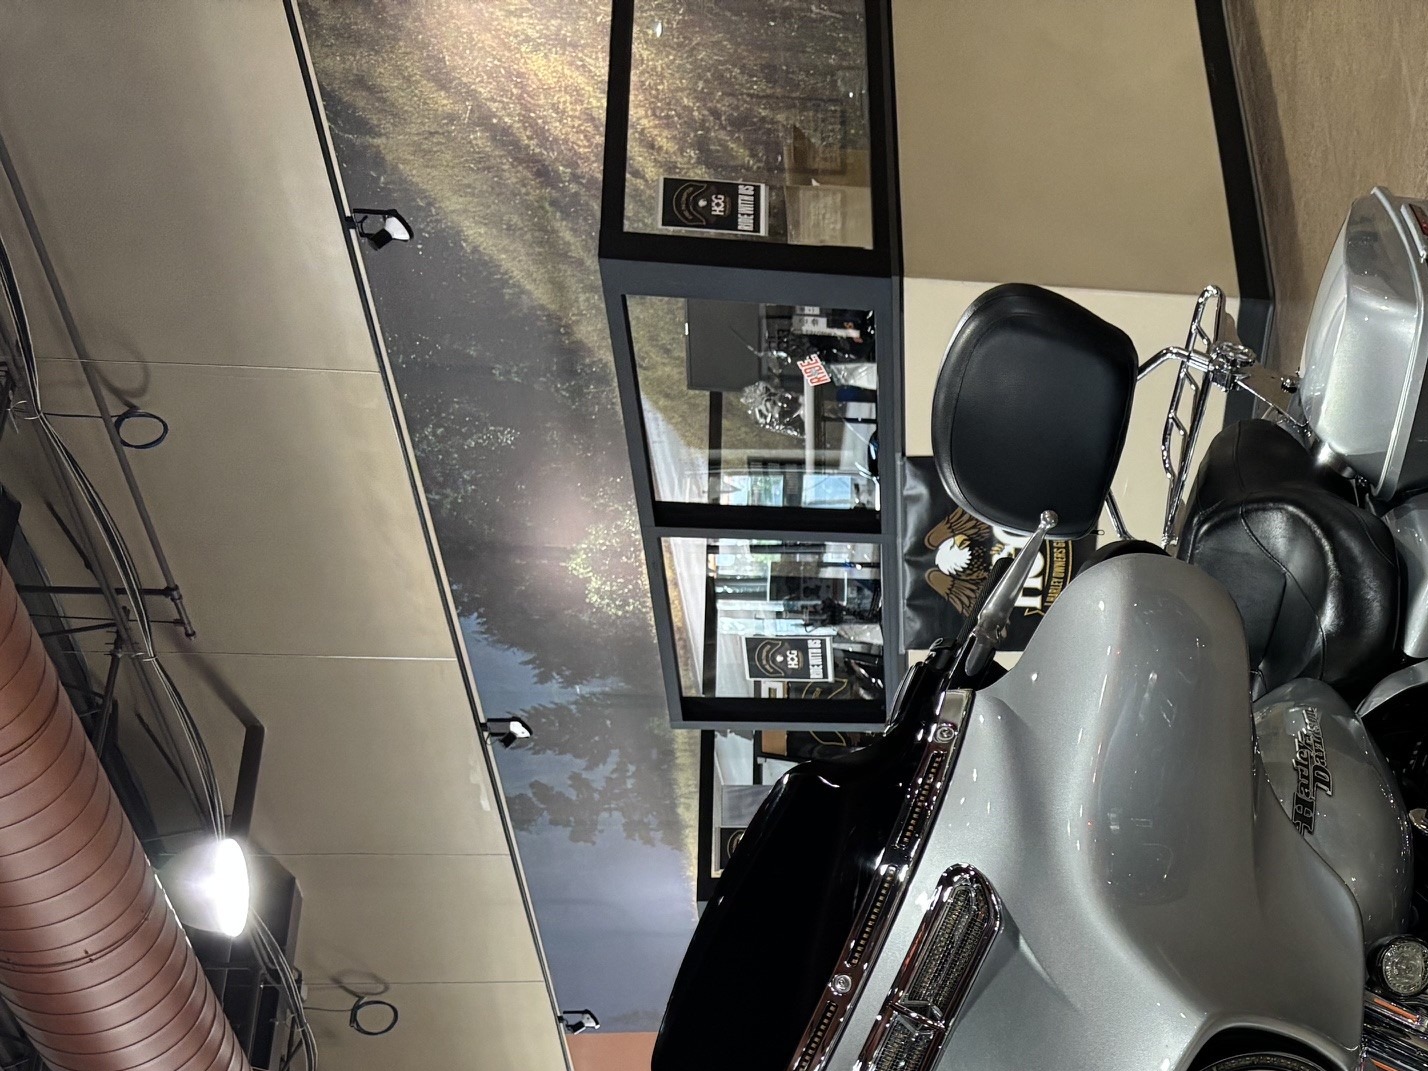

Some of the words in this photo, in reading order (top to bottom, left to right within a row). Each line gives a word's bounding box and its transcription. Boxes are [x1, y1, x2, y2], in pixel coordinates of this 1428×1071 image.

[738, 184, 754, 195] US
[737, 195, 754, 214] WITH
[737, 214, 754, 231] RIDE
[1052, 547, 1066, 578] OWNERS
[807, 639, 822, 648] US
[808, 648, 822, 664] WITH
